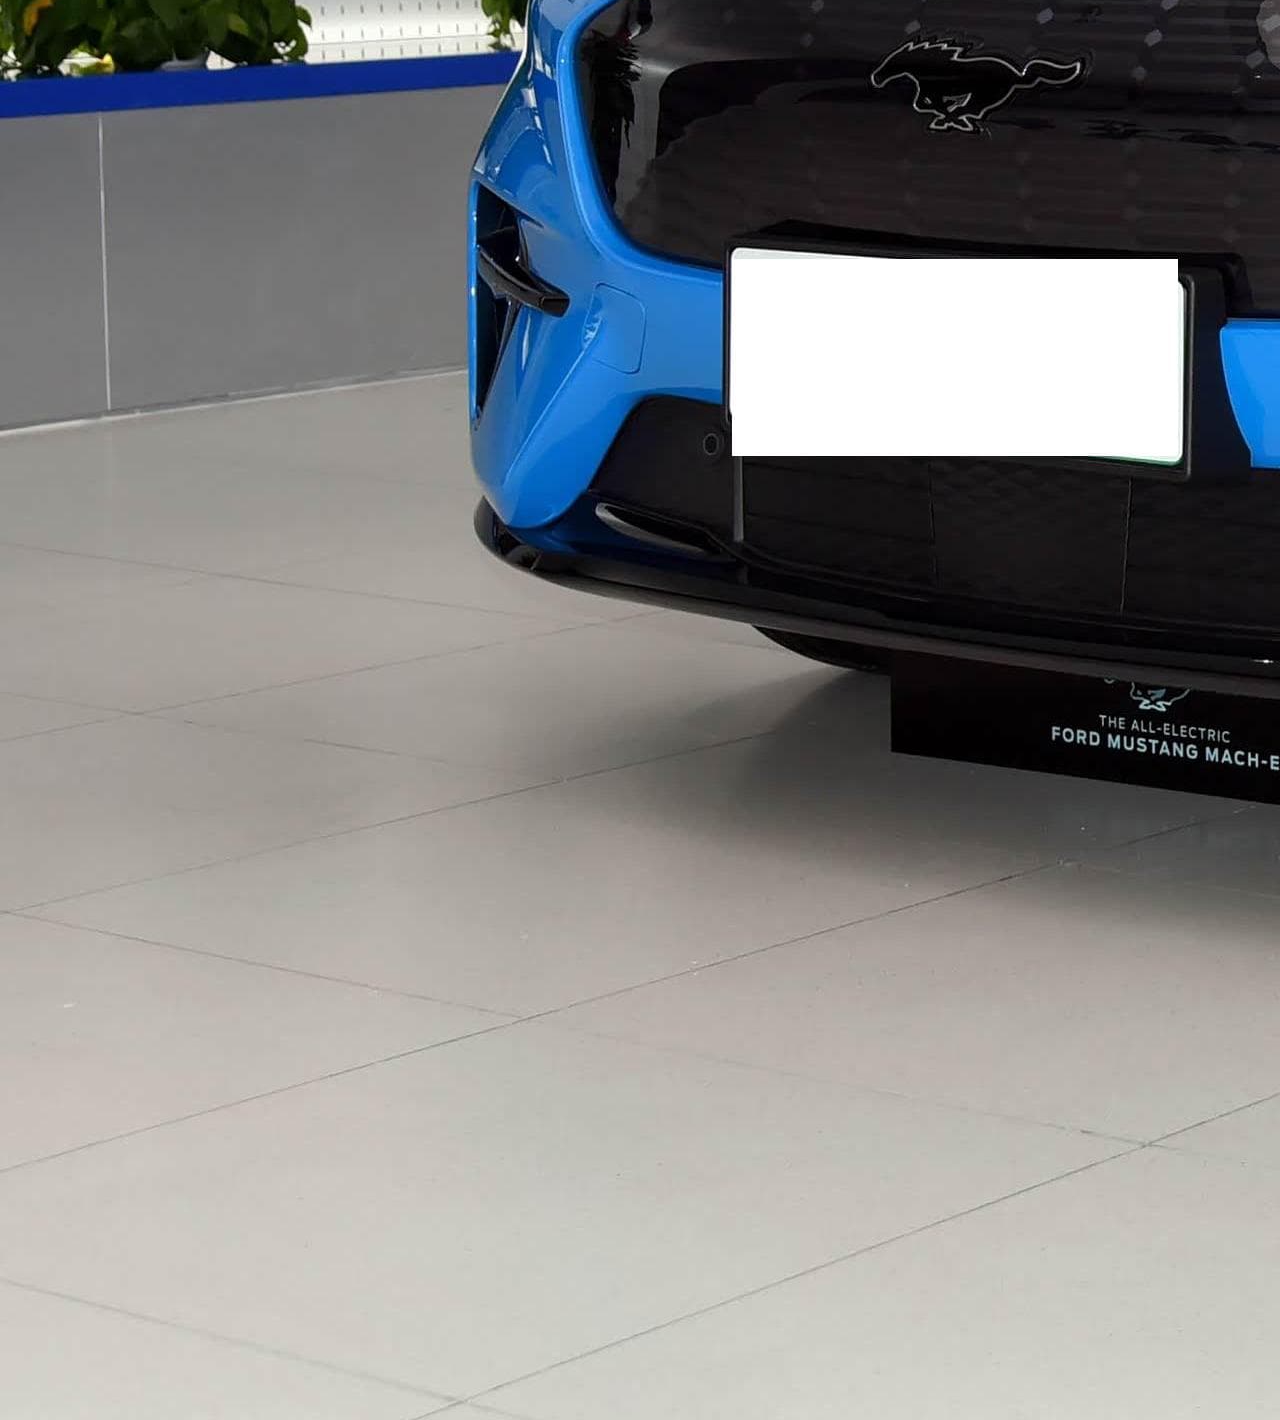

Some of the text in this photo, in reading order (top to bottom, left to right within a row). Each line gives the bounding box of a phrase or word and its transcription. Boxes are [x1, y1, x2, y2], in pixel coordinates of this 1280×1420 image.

[1099, 714, 1231, 743] THE ALL-ELECTRIC
[1051, 726, 1280, 770] FORD MUSTANG MACH-E
